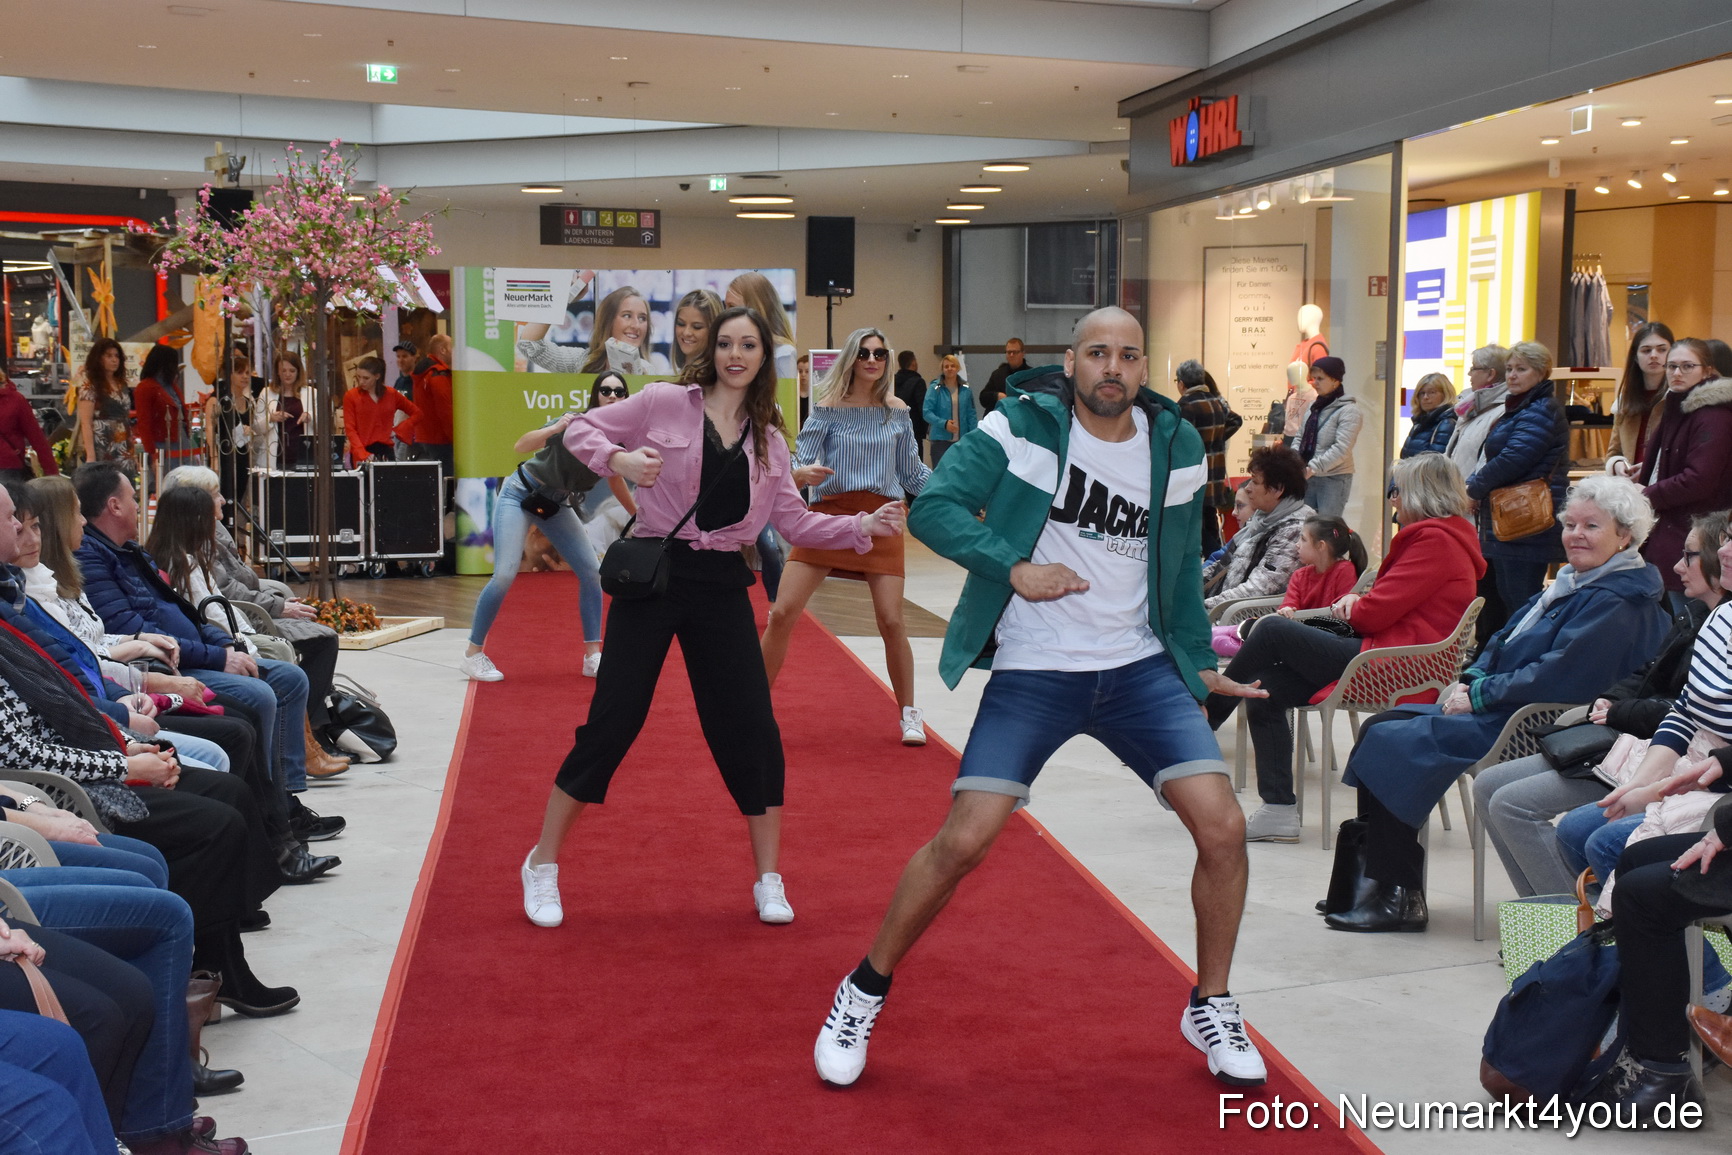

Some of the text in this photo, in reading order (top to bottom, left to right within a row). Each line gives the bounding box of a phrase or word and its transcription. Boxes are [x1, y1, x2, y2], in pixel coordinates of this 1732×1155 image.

[1169, 94, 1242, 167] WÖHRL
[1222, 265, 1244, 273] finden
[1246, 265, 1257, 273] Sie
[504, 293, 553, 302] NeuerMarkt
[523, 390, 564, 409] Von
